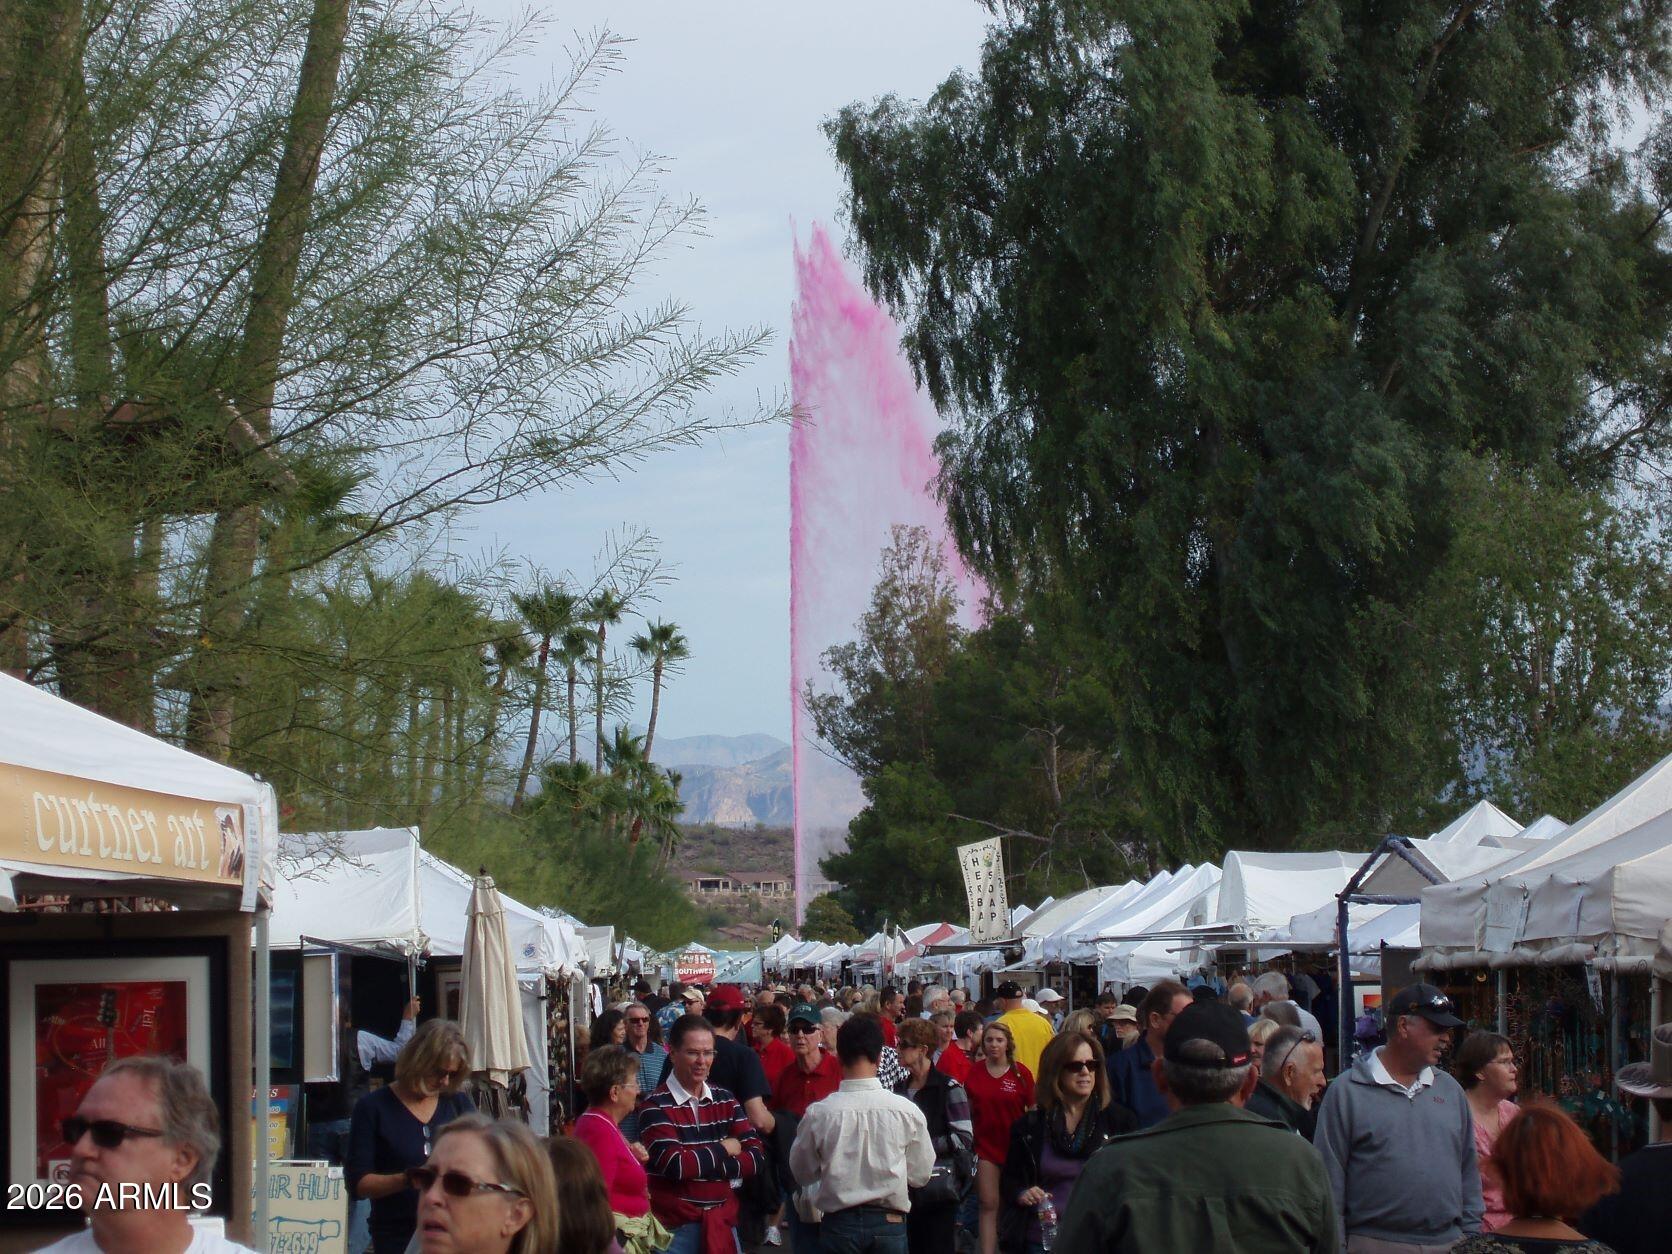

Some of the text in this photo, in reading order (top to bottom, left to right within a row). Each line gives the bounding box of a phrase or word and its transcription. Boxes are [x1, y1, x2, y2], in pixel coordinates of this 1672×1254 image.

[33, 791, 163, 863] curtner
[168, 808, 210, 870] art
[971, 857, 984, 934] HERBAL
[988, 871, 997, 921] SOAP
[297, 1173, 344, 1201] HUT
